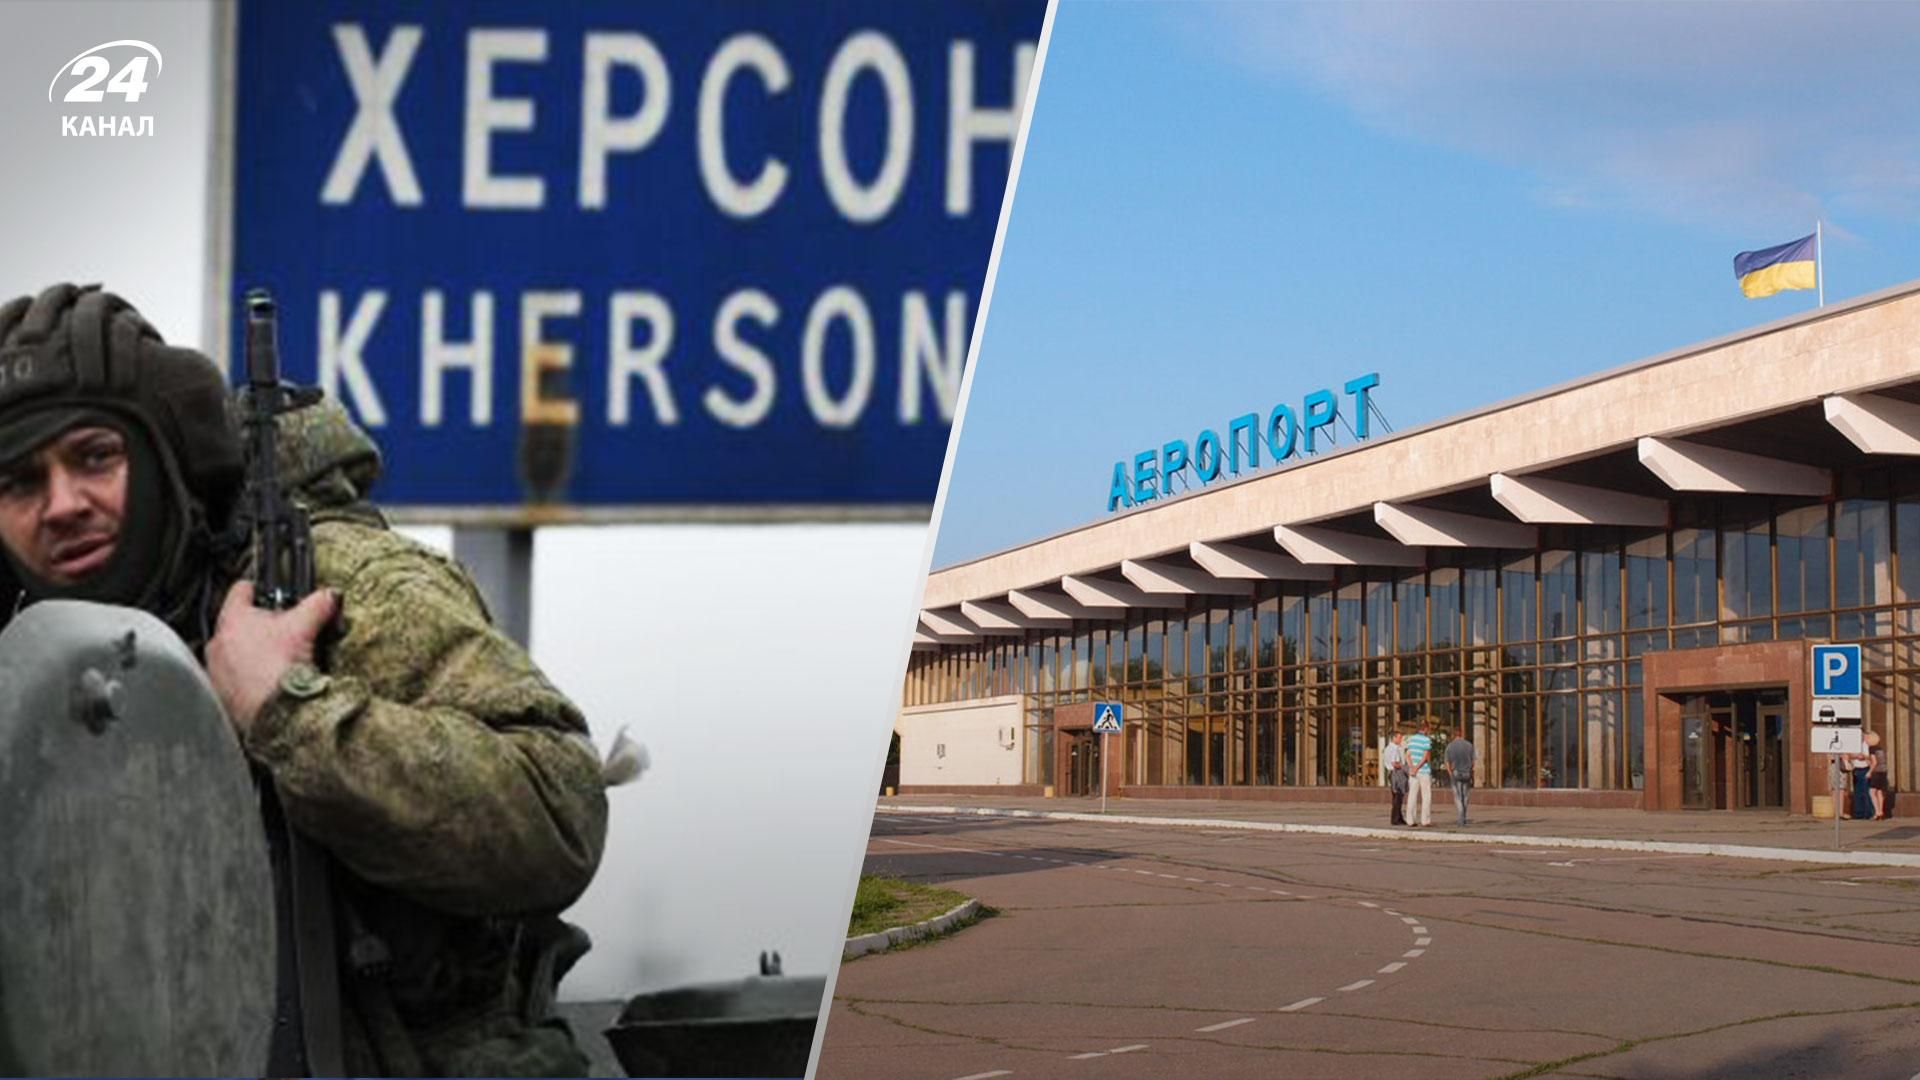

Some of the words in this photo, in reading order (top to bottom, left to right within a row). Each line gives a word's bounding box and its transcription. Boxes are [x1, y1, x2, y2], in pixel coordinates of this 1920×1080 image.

[319, 25, 1037, 223] ХЕРСОН
[317, 286, 968, 427] KHERSON
[1108, 372, 1380, 512] АЕРОПОРТ
[1823, 652, 1848, 689] P
